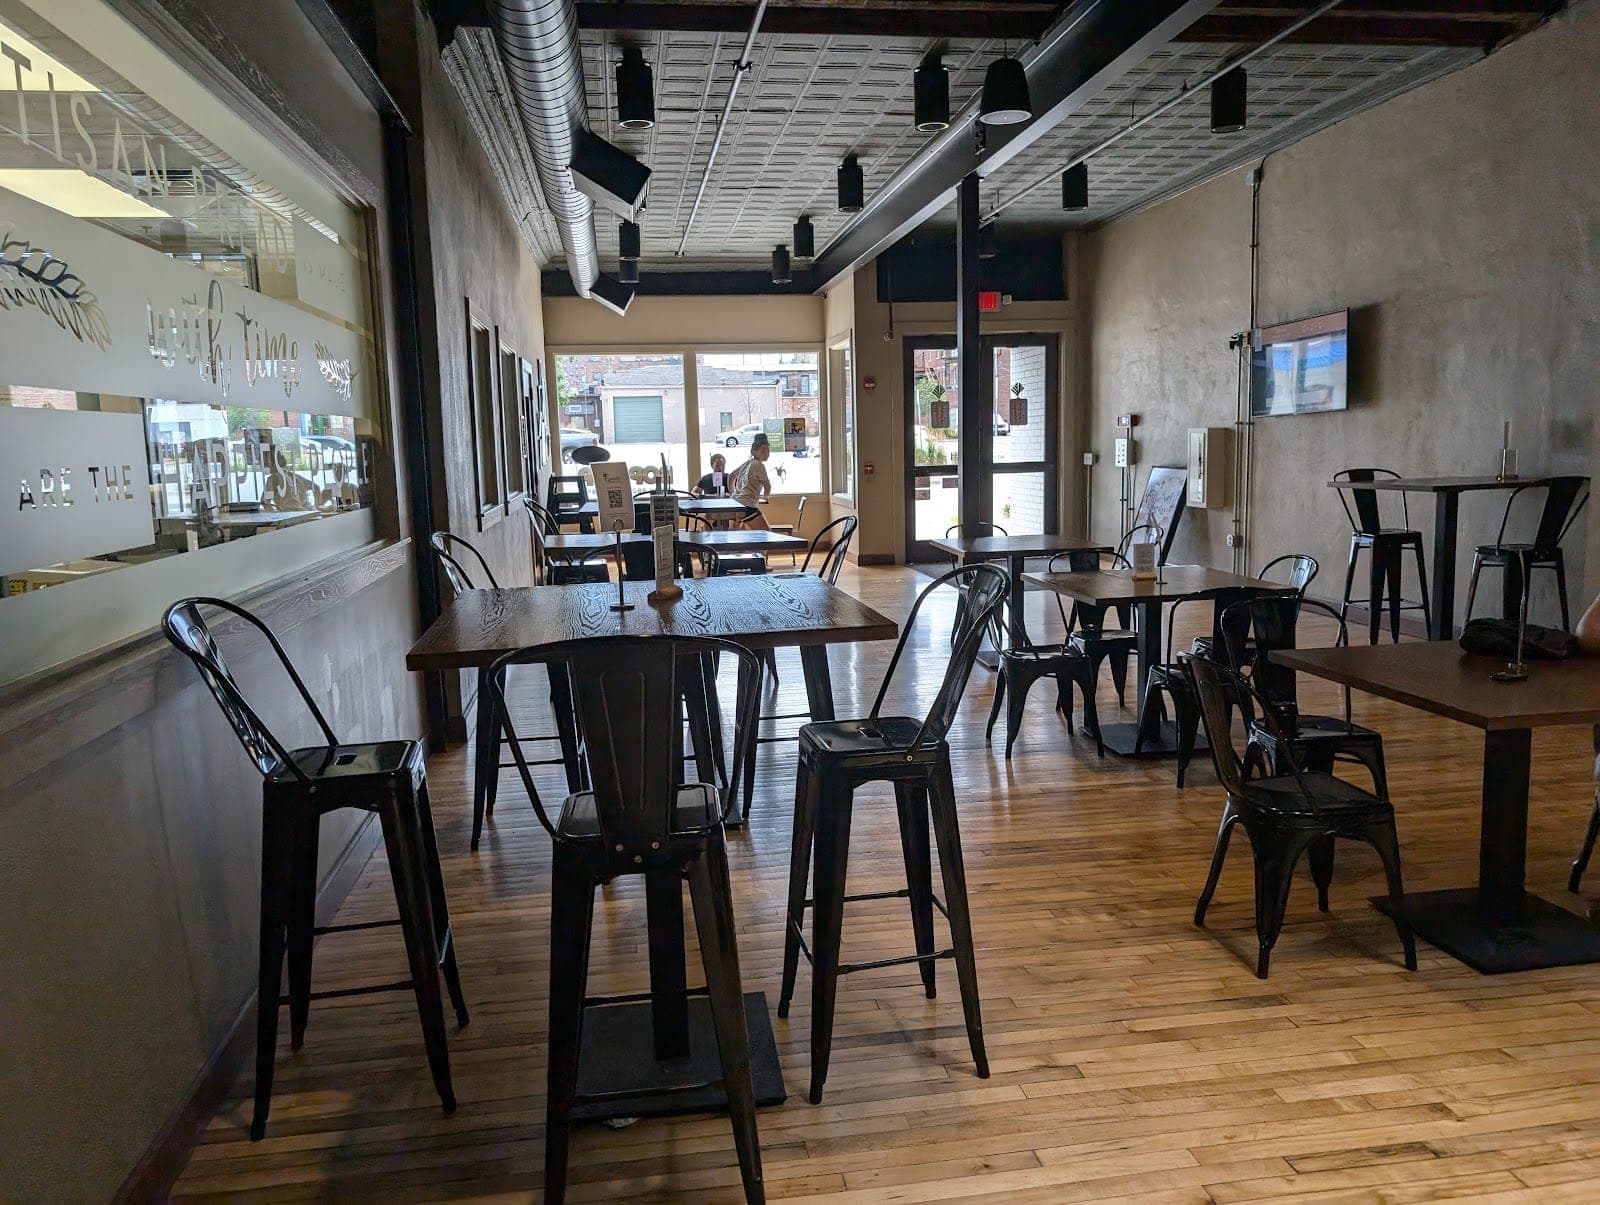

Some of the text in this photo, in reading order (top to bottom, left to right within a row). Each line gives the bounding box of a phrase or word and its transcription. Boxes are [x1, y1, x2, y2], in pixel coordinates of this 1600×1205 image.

[19, 467, 75, 511] ARE
[88, 465, 134, 503] THE
[160, 441, 303, 516] HAPPIEST
